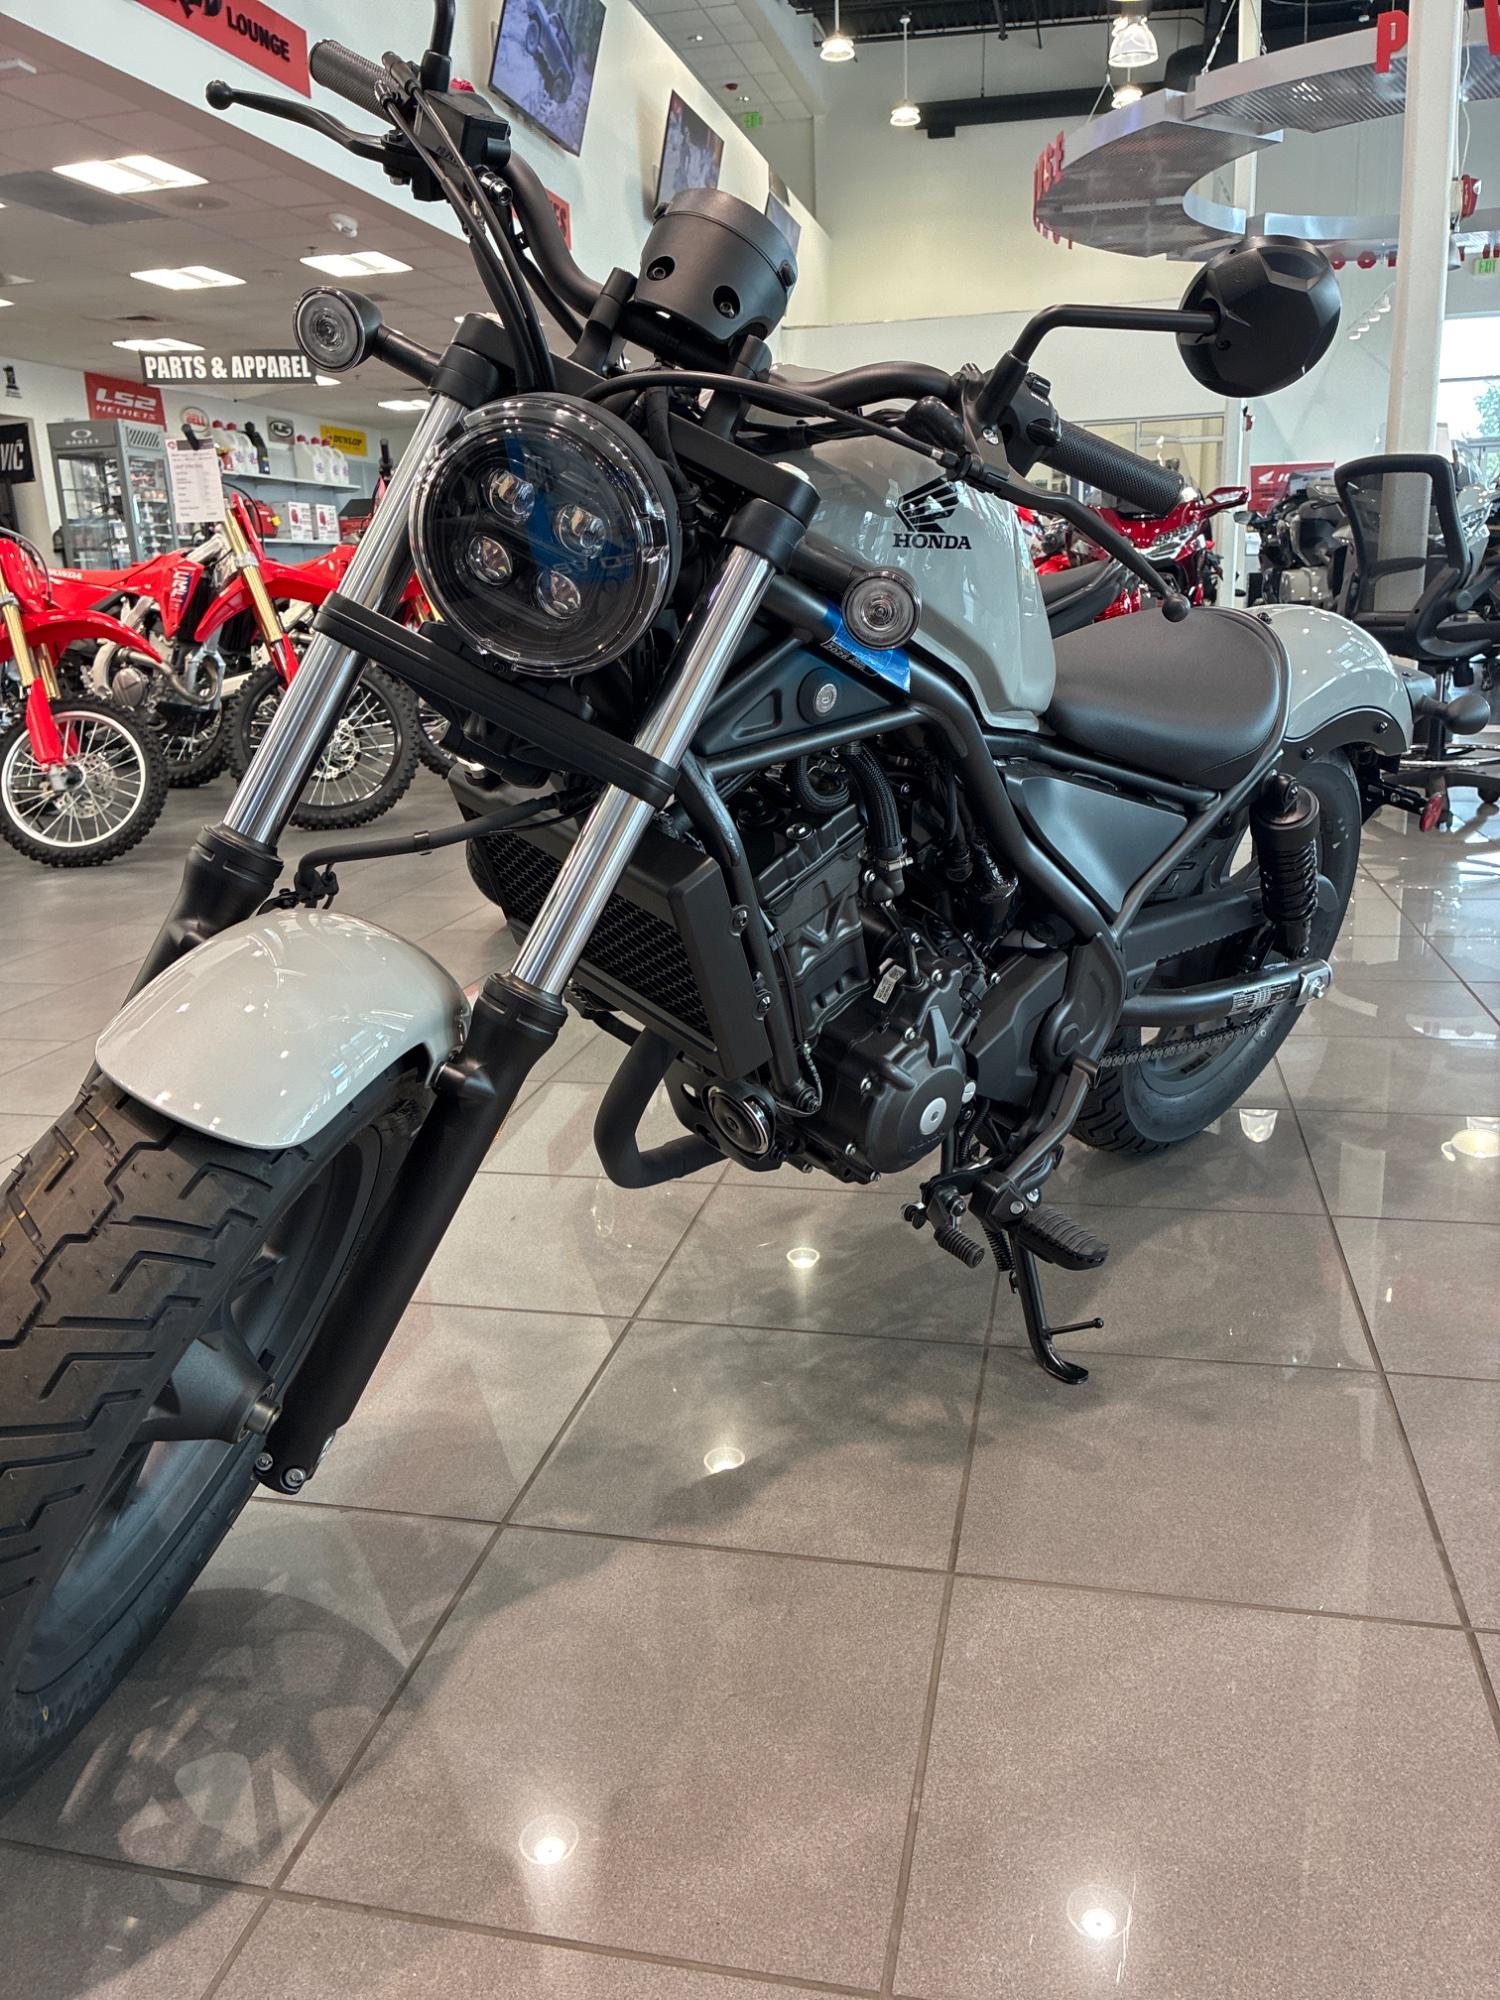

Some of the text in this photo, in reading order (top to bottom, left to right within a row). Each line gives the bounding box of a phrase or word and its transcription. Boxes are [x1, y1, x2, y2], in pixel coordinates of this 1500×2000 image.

[226, 6, 291, 62] LOUNGE
[1479, 259, 1497, 273] EXIT
[144, 355, 312, 379] PARTS & APPAREL
[96, 387, 157, 412] LS2
[333, 434, 362, 448] DUNLOP
[891, 532, 972, 550] HONDA
